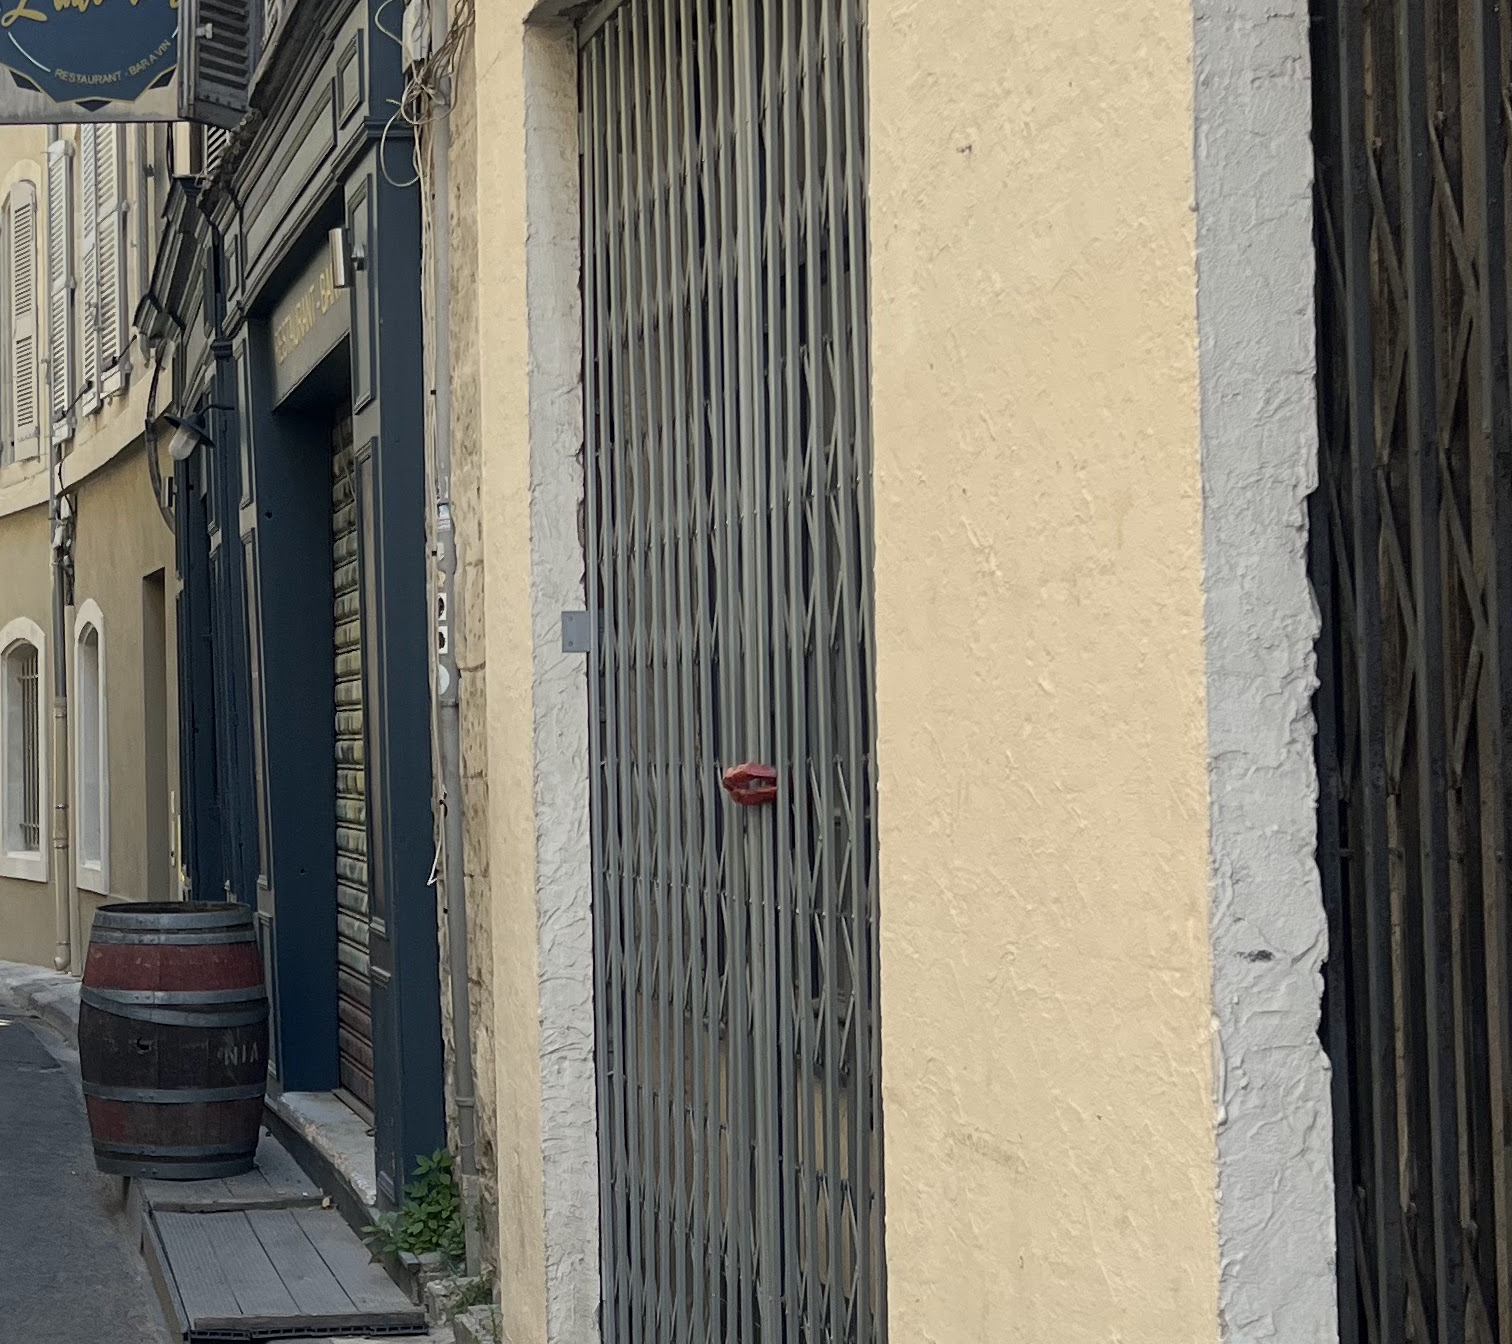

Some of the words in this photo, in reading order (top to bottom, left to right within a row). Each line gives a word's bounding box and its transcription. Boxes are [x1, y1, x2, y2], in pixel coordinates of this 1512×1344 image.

[55, 68, 121, 85] RESTAURANT
[128, 58, 150, 76] BAR
[154, 39, 171, 56] VIN
